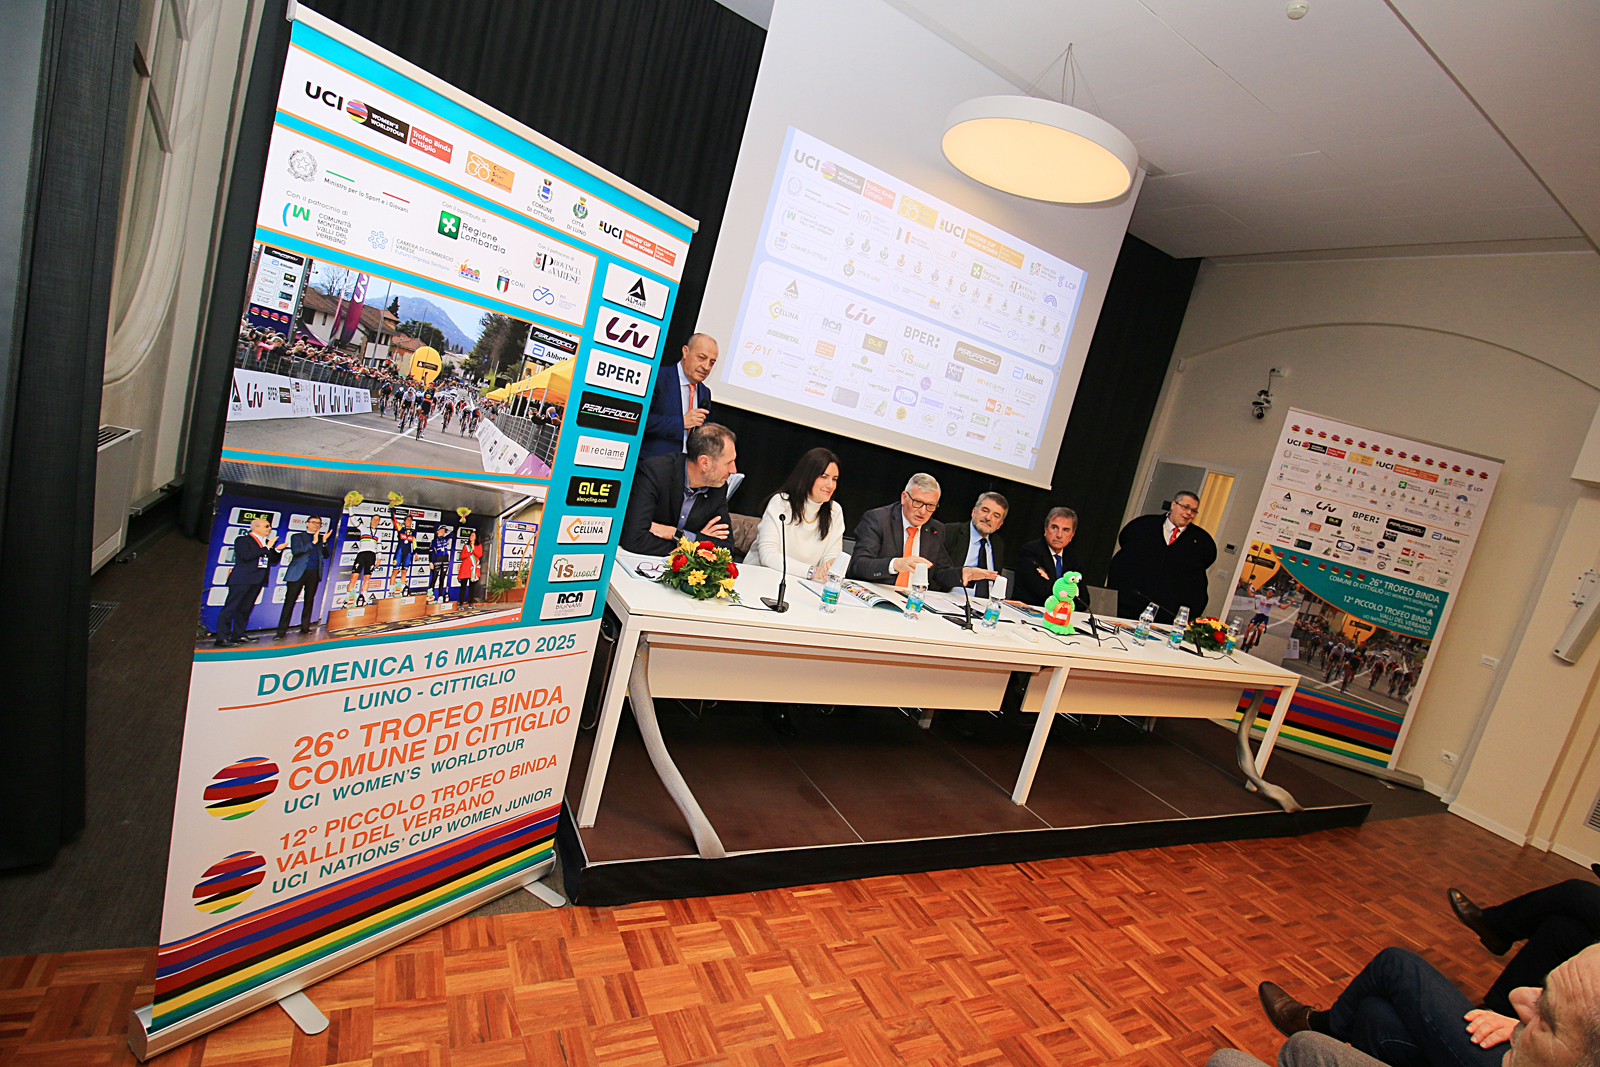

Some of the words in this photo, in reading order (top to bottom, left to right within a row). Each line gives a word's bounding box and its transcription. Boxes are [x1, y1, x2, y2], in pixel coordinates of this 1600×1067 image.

[305, 81, 343, 111] UCI
[370, 118, 405, 139] WORLDTOUR
[372, 112, 399, 130] WOMEN'S
[411, 139, 437, 154] Cittiglio
[412, 130, 433, 145] Trofeo
[434, 140, 452, 153] Binda
[794, 149, 821, 171] UCI
[286, 189, 301, 201] Con
[307, 197, 341, 214] patrocinio
[323, 177, 348, 192] Ministro
[388, 201, 409, 214] Giovani
[531, 200, 553, 214] COMUNE
[532, 208, 555, 223] CITTIGLIO
[461, 222, 498, 242] Regione
[572, 226, 587, 237] LUINO
[603, 222, 623, 240] UCI
[944, 220, 965, 239] UCI
[396, 238, 419, 250] CAMERA
[460, 232, 506, 254] Lombardia
[510, 280, 526, 289] CONI
[624, 295, 647, 308] ALMAR
[844, 303, 876, 325] Liv
[605, 316, 650, 349] Liv
[590, 446, 625, 458] reclame
[1287, 438, 1302, 447] UCI
[1379, 461, 1394, 470] UCI
[1315, 501, 1337, 513] Liv
[573, 525, 604, 534] CELLINA
[1328, 575, 1352, 586] COMUNE
[1359, 583, 1384, 594] CITTIGLIO
[1384, 581, 1415, 597] TROFEO
[1415, 590, 1440, 604] BINDA
[1354, 598, 1383, 612] PICCOLO
[1385, 606, 1411, 619] TROFEO
[1411, 614, 1432, 625] BINDA
[256, 654, 414, 696] DOMENICA
[423, 650, 448, 669] 16
[454, 638, 531, 666] MARZO
[534, 633, 577, 653] 2025
[343, 686, 412, 713] LUINO
[429, 668, 516, 698] CITTIGLIO
[291, 728, 350, 763] 26°
[359, 700, 484, 749] TROFEO
[489, 685, 564, 716] BINDA
[287, 741, 428, 791] COMUNE
[433, 731, 460, 760] DI
[465, 706, 571, 752] CITTIGLIO
[283, 792, 321, 814] UCI
[331, 766, 421, 801] WOMEN'S
[430, 738, 525, 775] WORLDTOUR
[279, 825, 317, 851] 12°
[323, 794, 426, 839] PICCOLO
[430, 769, 506, 803] TROFEO
[508, 754, 558, 780] BINDA
[271, 874, 308, 895] UCI
[318, 839, 405, 879] NATIONS'
[407, 825, 443, 847] CUP
[446, 804, 502, 835] WOMEN
[504, 787, 553, 813] JUNIOR
[275, 841, 348, 873] VALLI
[351, 825, 395, 850] DEL
[401, 790, 495, 832] VERBANO
